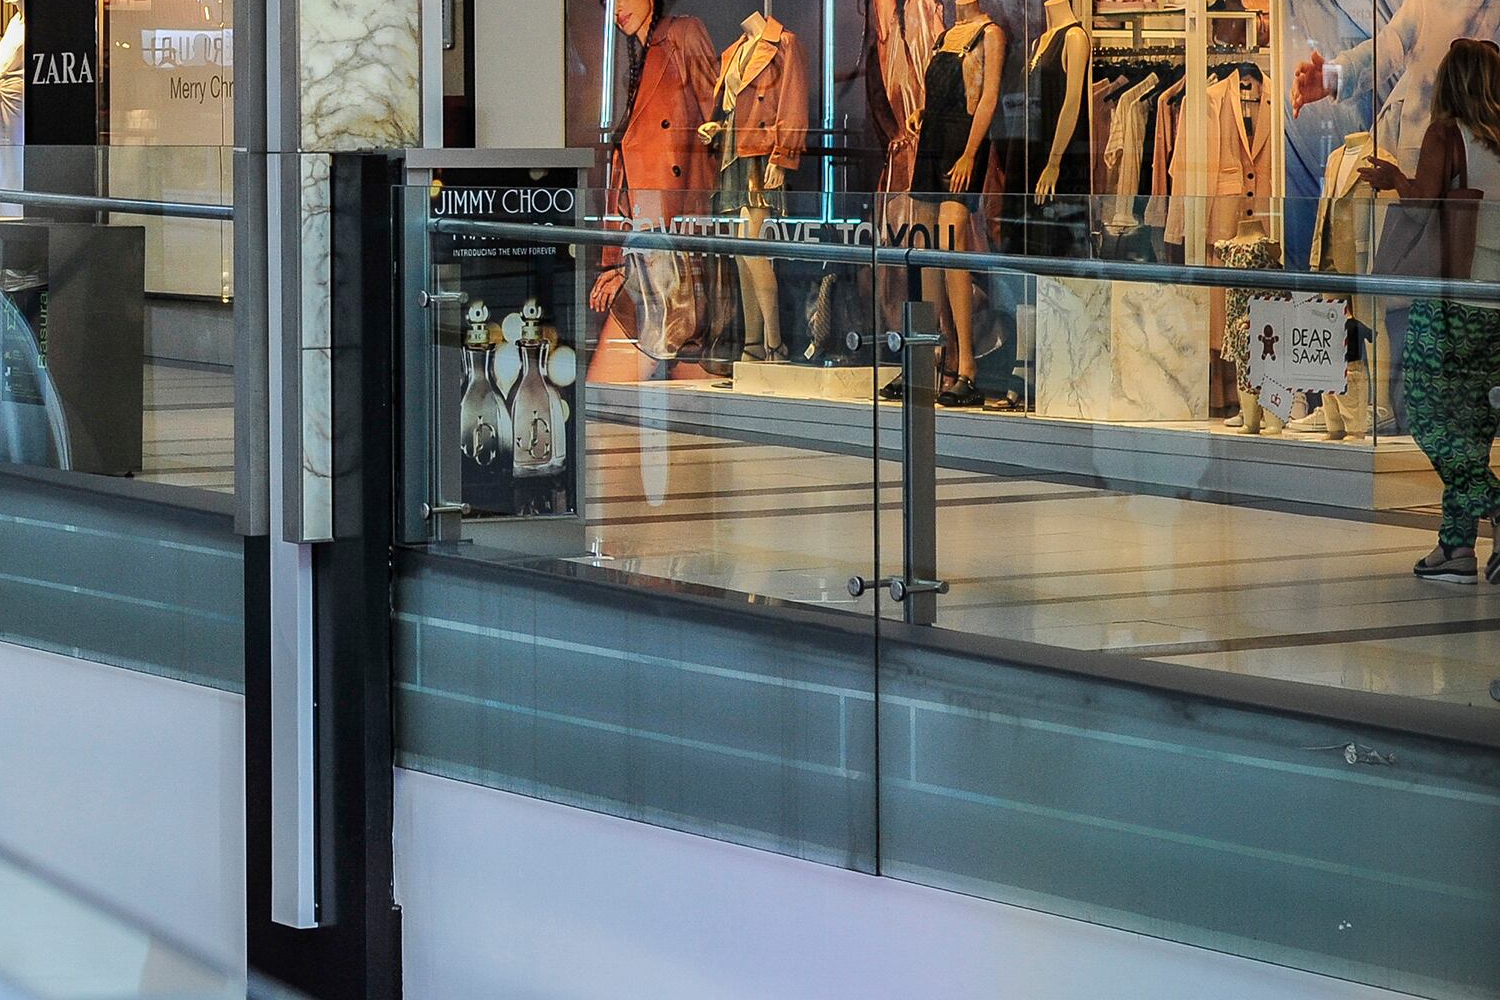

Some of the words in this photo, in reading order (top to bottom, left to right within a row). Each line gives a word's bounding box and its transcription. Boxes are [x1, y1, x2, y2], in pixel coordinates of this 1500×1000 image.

[32, 52, 94, 85] ZARA
[170, 76, 206, 104] Merry
[434, 190, 496, 215] JIMMY
[502, 188, 574, 214] CHOO
[453, 248, 497, 257] INTRODUCING
[499, 247, 510, 256] THE
[512, 247, 527, 256] NEW
[529, 246, 556, 255] FOREVER
[1292, 327, 1332, 349] DEAR
[1292, 348, 1332, 366] SANTA
